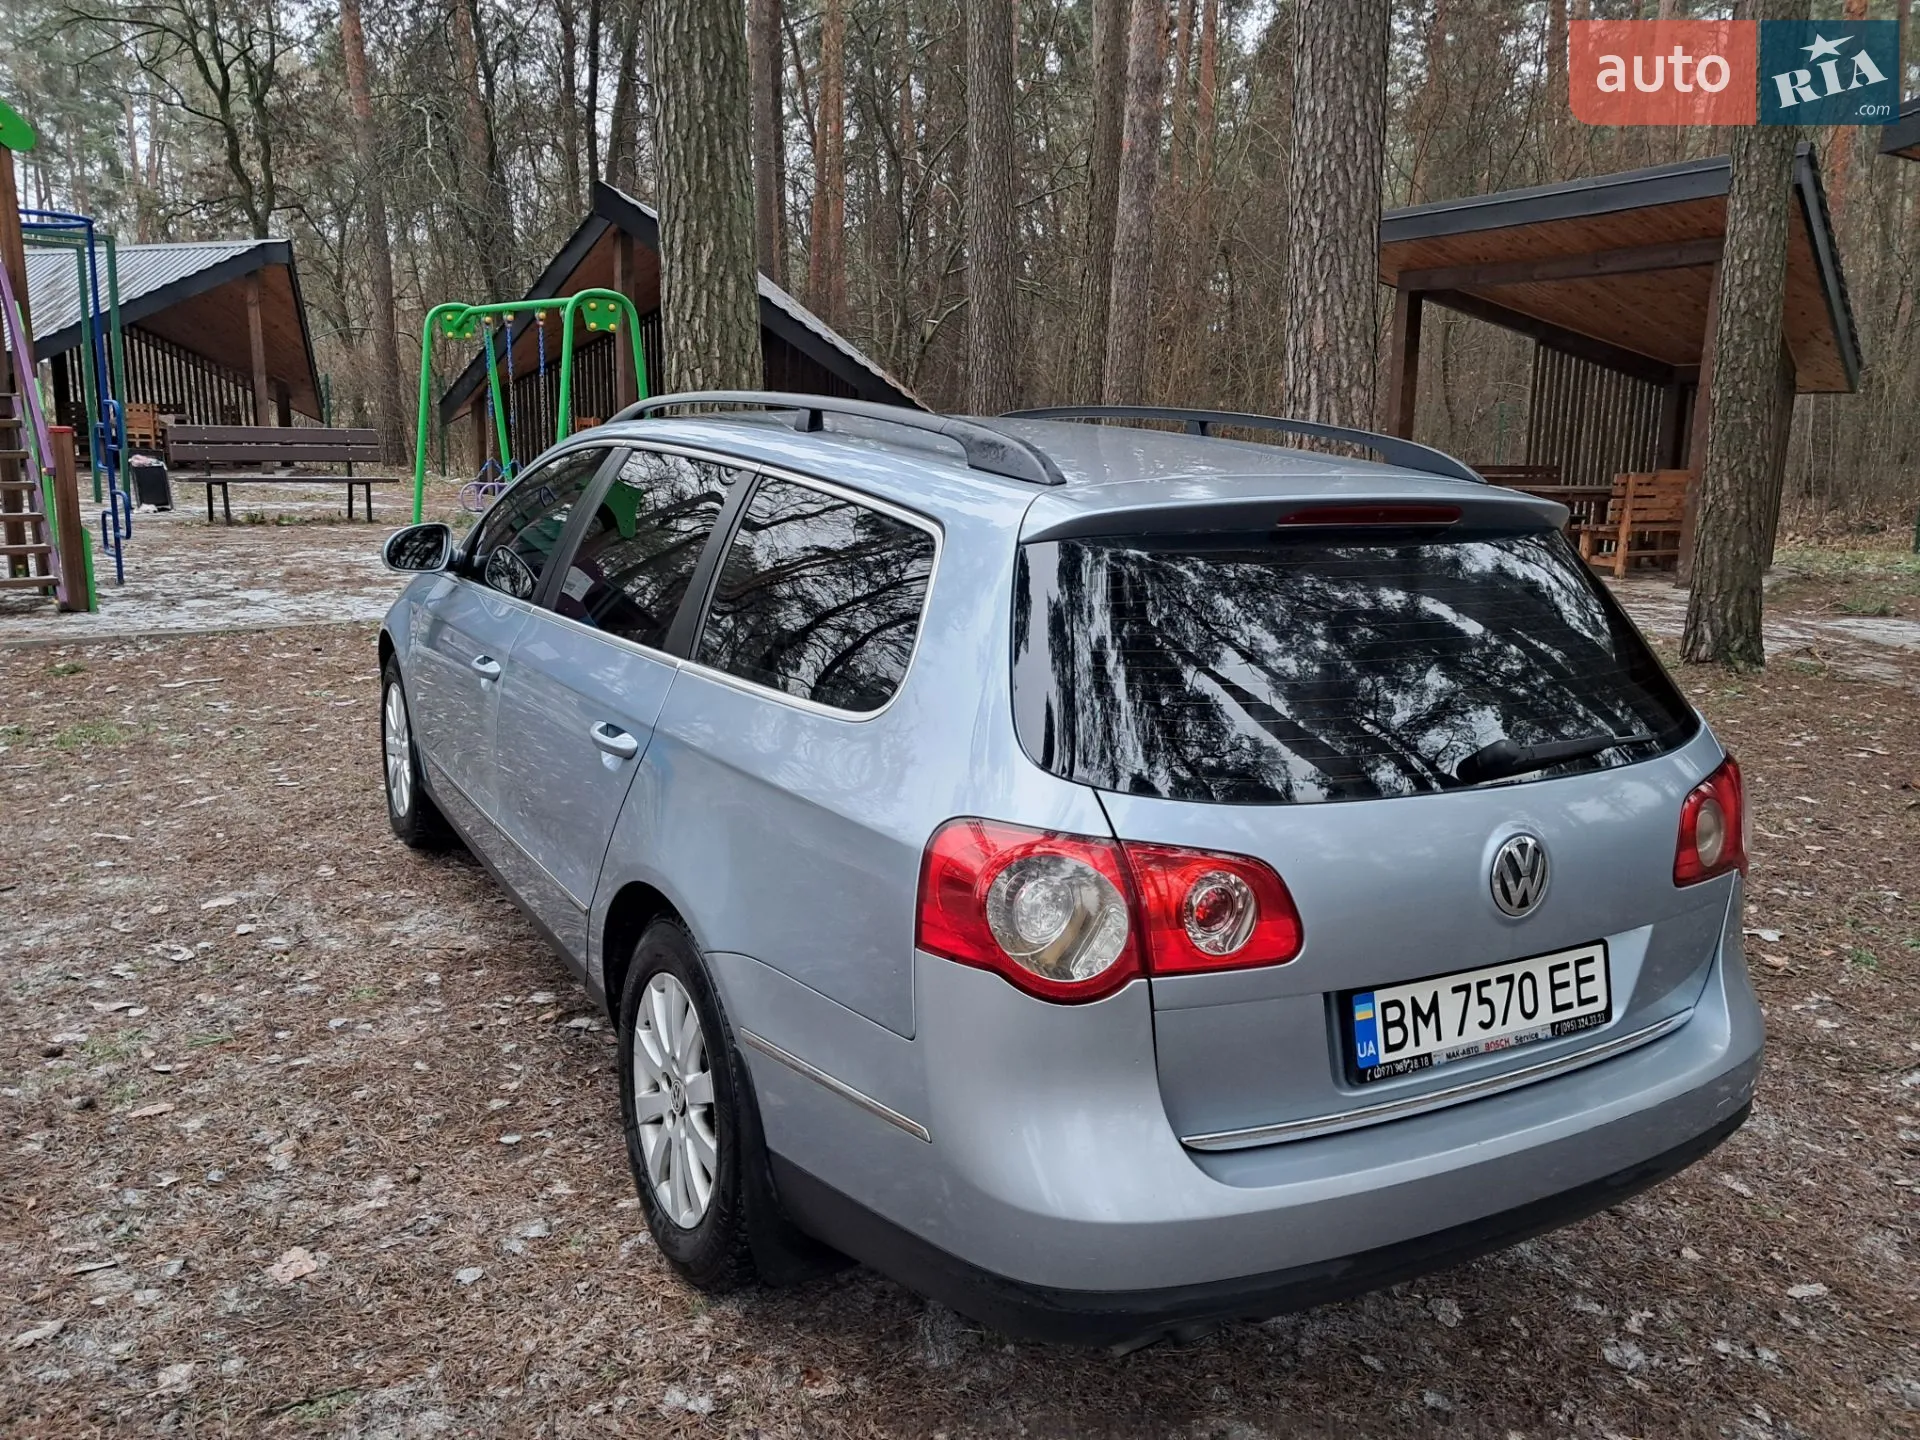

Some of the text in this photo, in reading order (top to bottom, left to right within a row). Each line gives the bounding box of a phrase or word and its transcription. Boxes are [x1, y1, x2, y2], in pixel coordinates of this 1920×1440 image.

[1380, 955, 1599, 1054] BM 7570 EE
[1357, 1040, 1376, 1058] UA
[1484, 1037, 1511, 1052] BOSCH
[1514, 1032, 1539, 1044] Service
